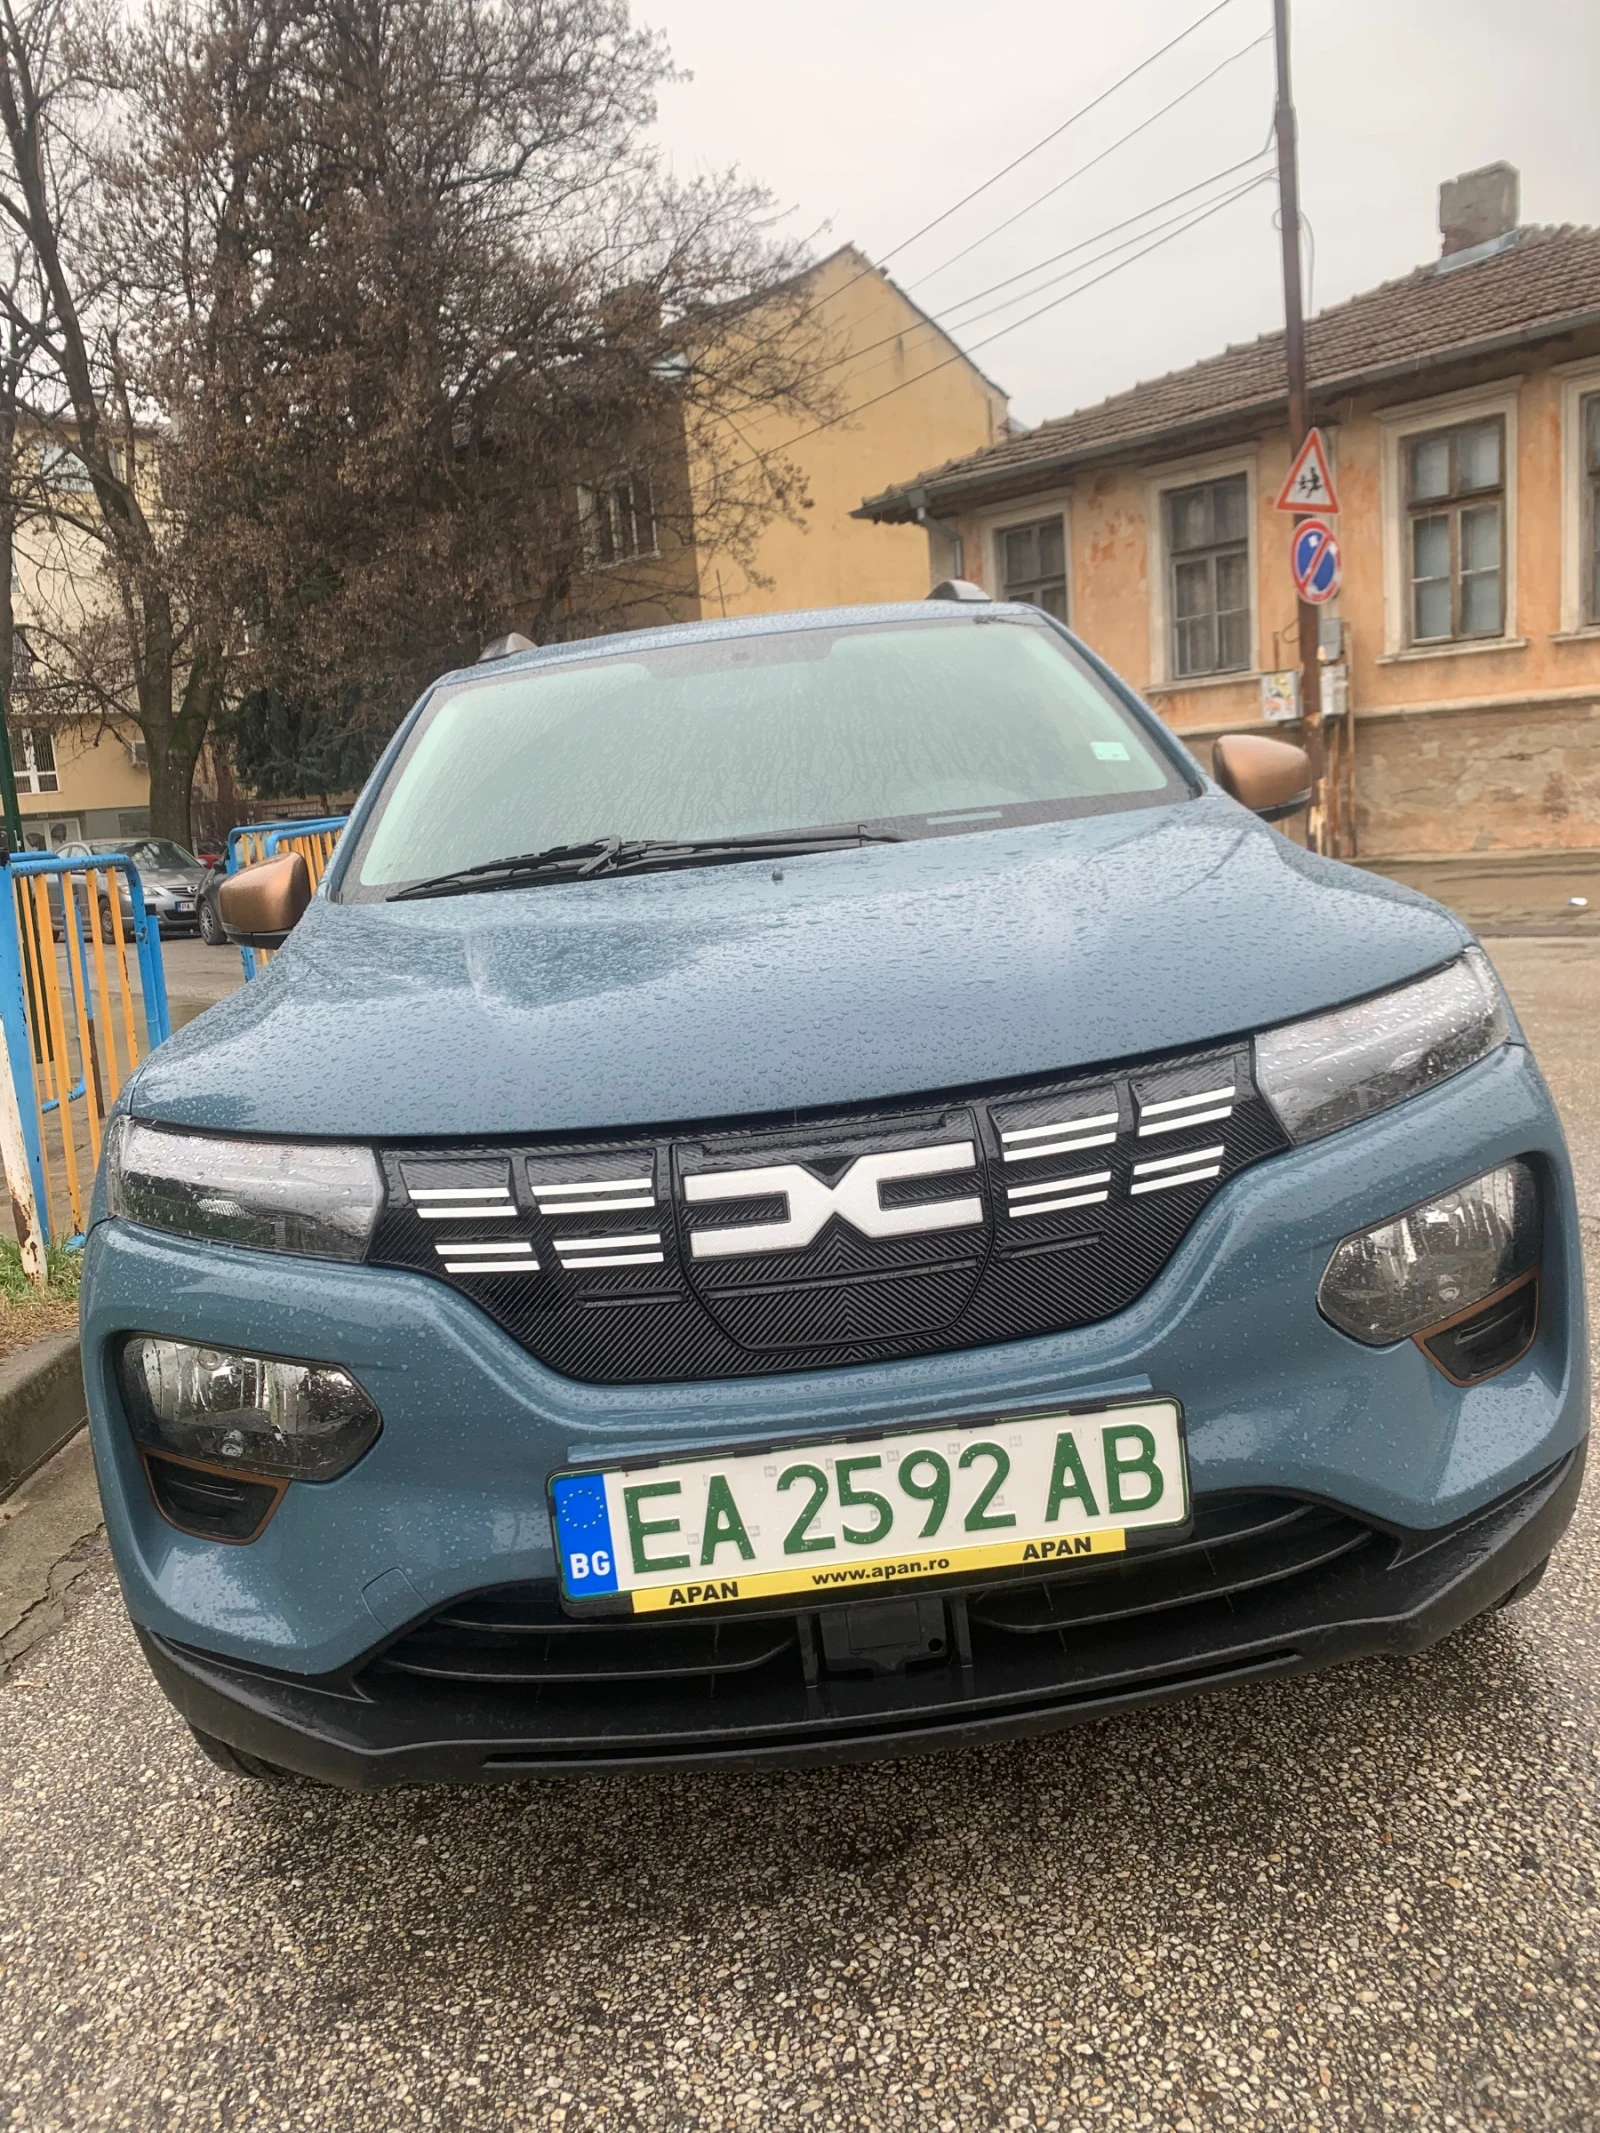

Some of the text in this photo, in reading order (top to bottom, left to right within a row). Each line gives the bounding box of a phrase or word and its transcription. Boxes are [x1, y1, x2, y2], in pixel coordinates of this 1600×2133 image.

[623, 1424, 1165, 1574] EA 2592 AB
[570, 1551, 611, 1579] BG
[669, 1536, 1092, 1606] APAN www.apan.ro APAN
